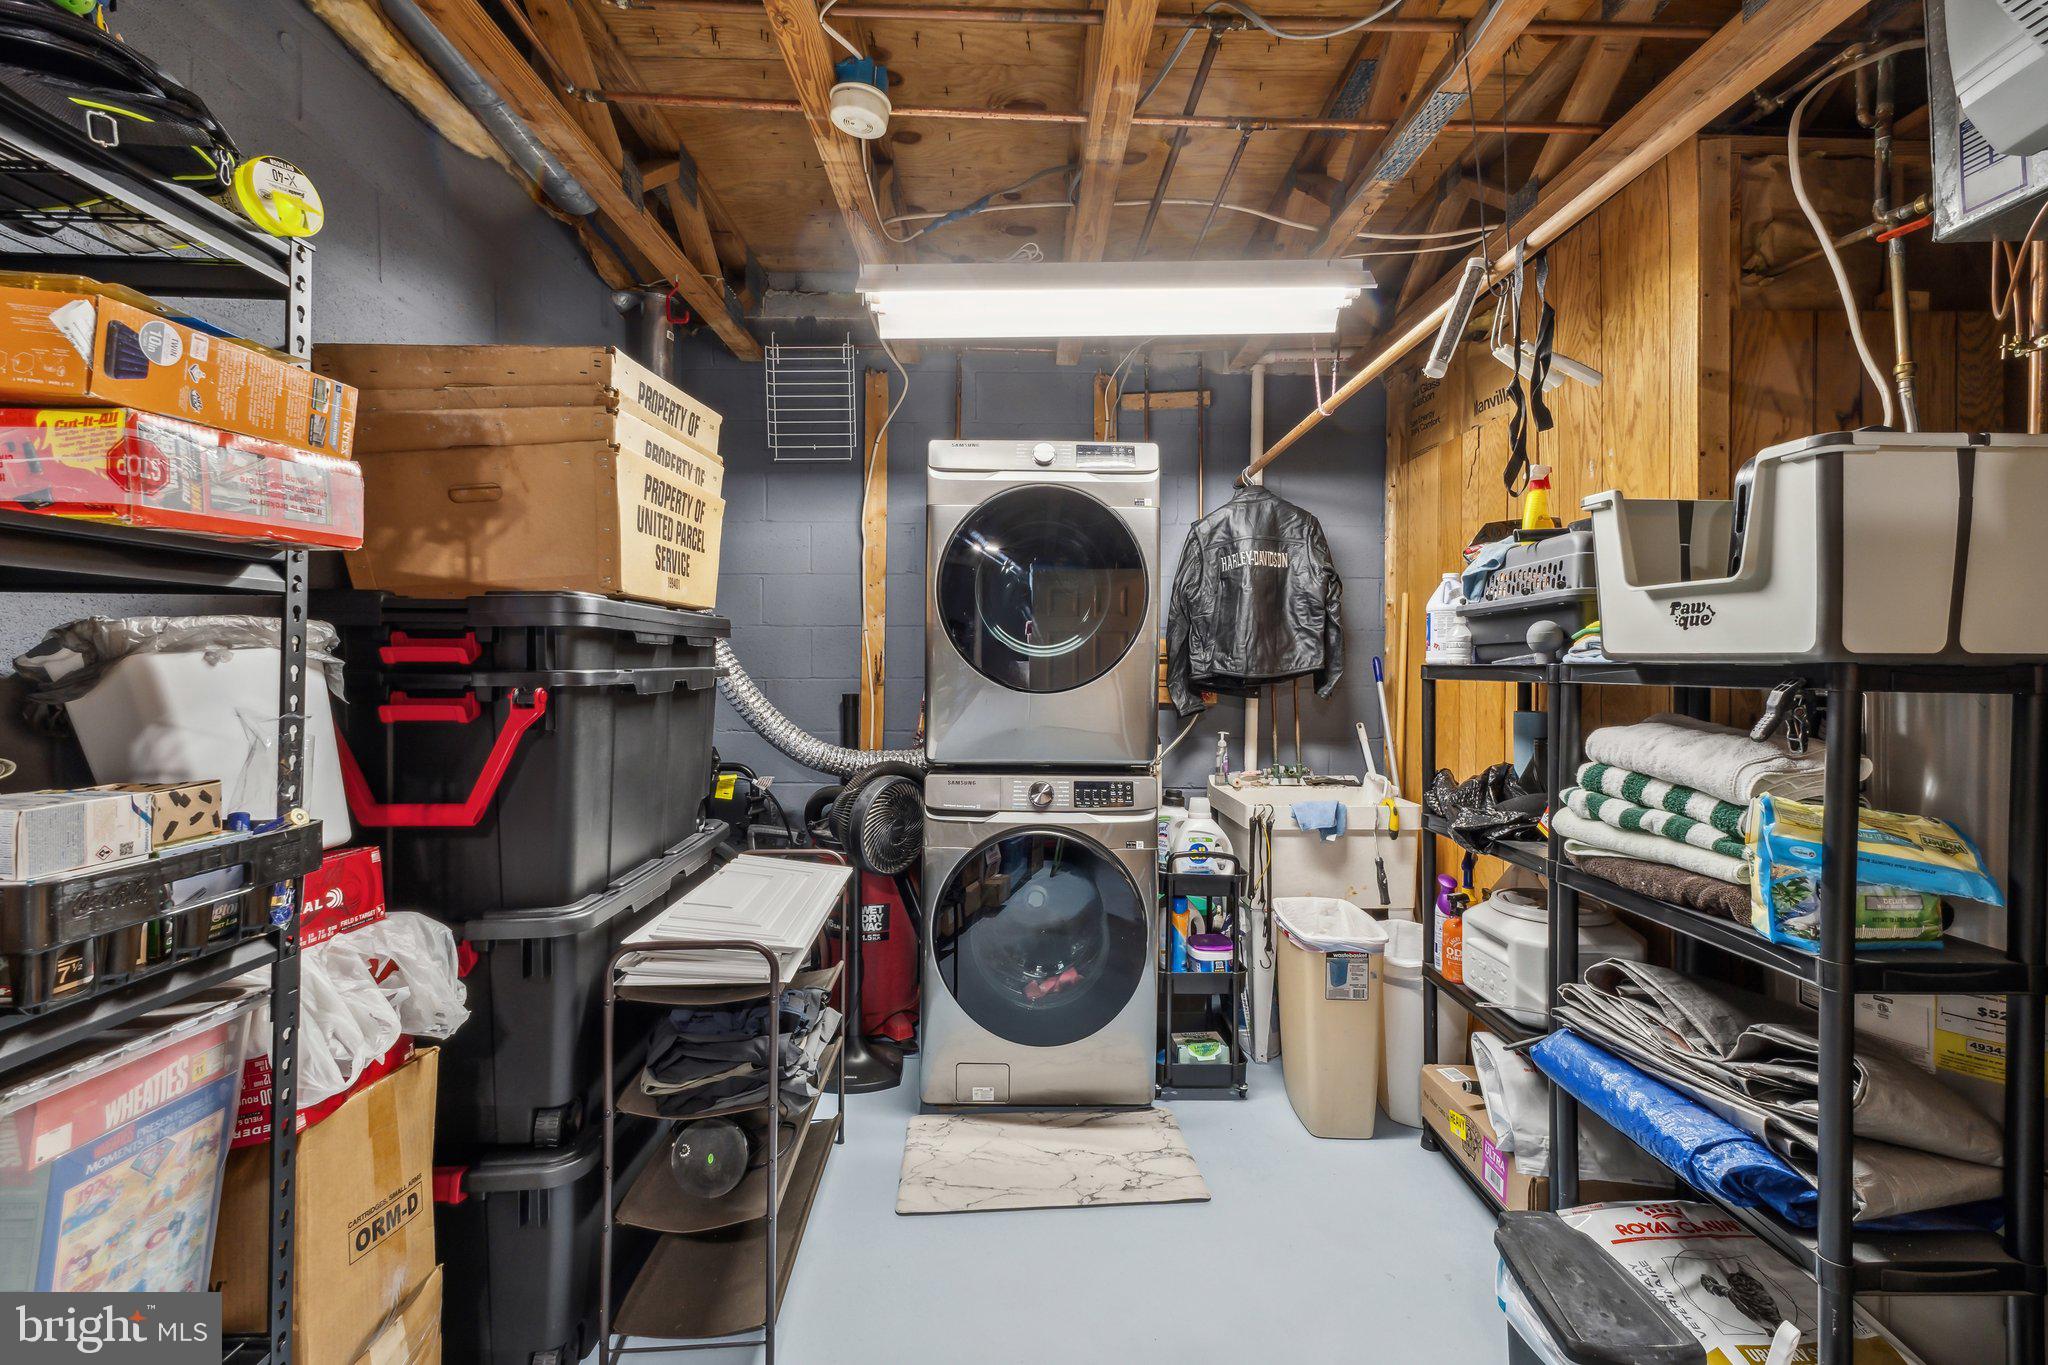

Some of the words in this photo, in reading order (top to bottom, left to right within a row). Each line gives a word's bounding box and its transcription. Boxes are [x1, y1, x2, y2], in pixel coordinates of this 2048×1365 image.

[271, 168, 297, 188] X-40
[168, 337, 179, 359] TWIN
[637, 380, 688, 433] PROPERTY
[687, 411, 701, 438] OF
[341, 421, 352, 455] INTEX
[115, 453, 164, 485] STOP
[644, 439, 694, 482] PROPERTY
[694, 466, 706, 487] OF
[644, 473, 694, 518] PROPERTY
[694, 498, 706, 524] OF
[637, 504, 674, 543] UNITED
[675, 521, 706, 554] PARCEL
[655, 543, 690, 578] SERVICE
[1220, 550, 1289, 573] HARLEY-DAVIDSON
[1670, 601, 1706, 616] Paw
[1677, 614, 1713, 630] que
[1921, 837, 1965, 853] Wagner's
[340, 916, 355, 927] FIELD
[359, 909, 377, 922] TARGET
[861, 905, 884, 914] WET
[861, 914, 884, 923] DRY
[861, 922, 882, 931] VAC
[1446, 946, 1462, 957] OD
[1969, 1042, 2003, 1055] 4934
[105, 1055, 190, 1130] WHEATIES
[238, 1096, 259, 1106] ROU
[136, 1107, 184, 1139] PRESENTS
[232, 1124, 272, 1139] EDER
[243, 1116, 264, 1124] FIELD
[1450, 1109, 1466, 1132] HEAVY
[84, 1140, 145, 1176] MOMENTS
[146, 1133, 159, 1145] IN
[1485, 1142, 1505, 1173] ULTRA
[346, 1198, 388, 1229] CARTRIDGES,
[388, 1186, 409, 1205] SMALL
[408, 1173, 423, 1193] ARMS
[355, 1191, 421, 1252] ORM-D
[1614, 1221, 1677, 1236] ROYAL
[1677, 1218, 1742, 1235] CANIN
[1638, 1260, 1708, 1341] VETERINAIRE
